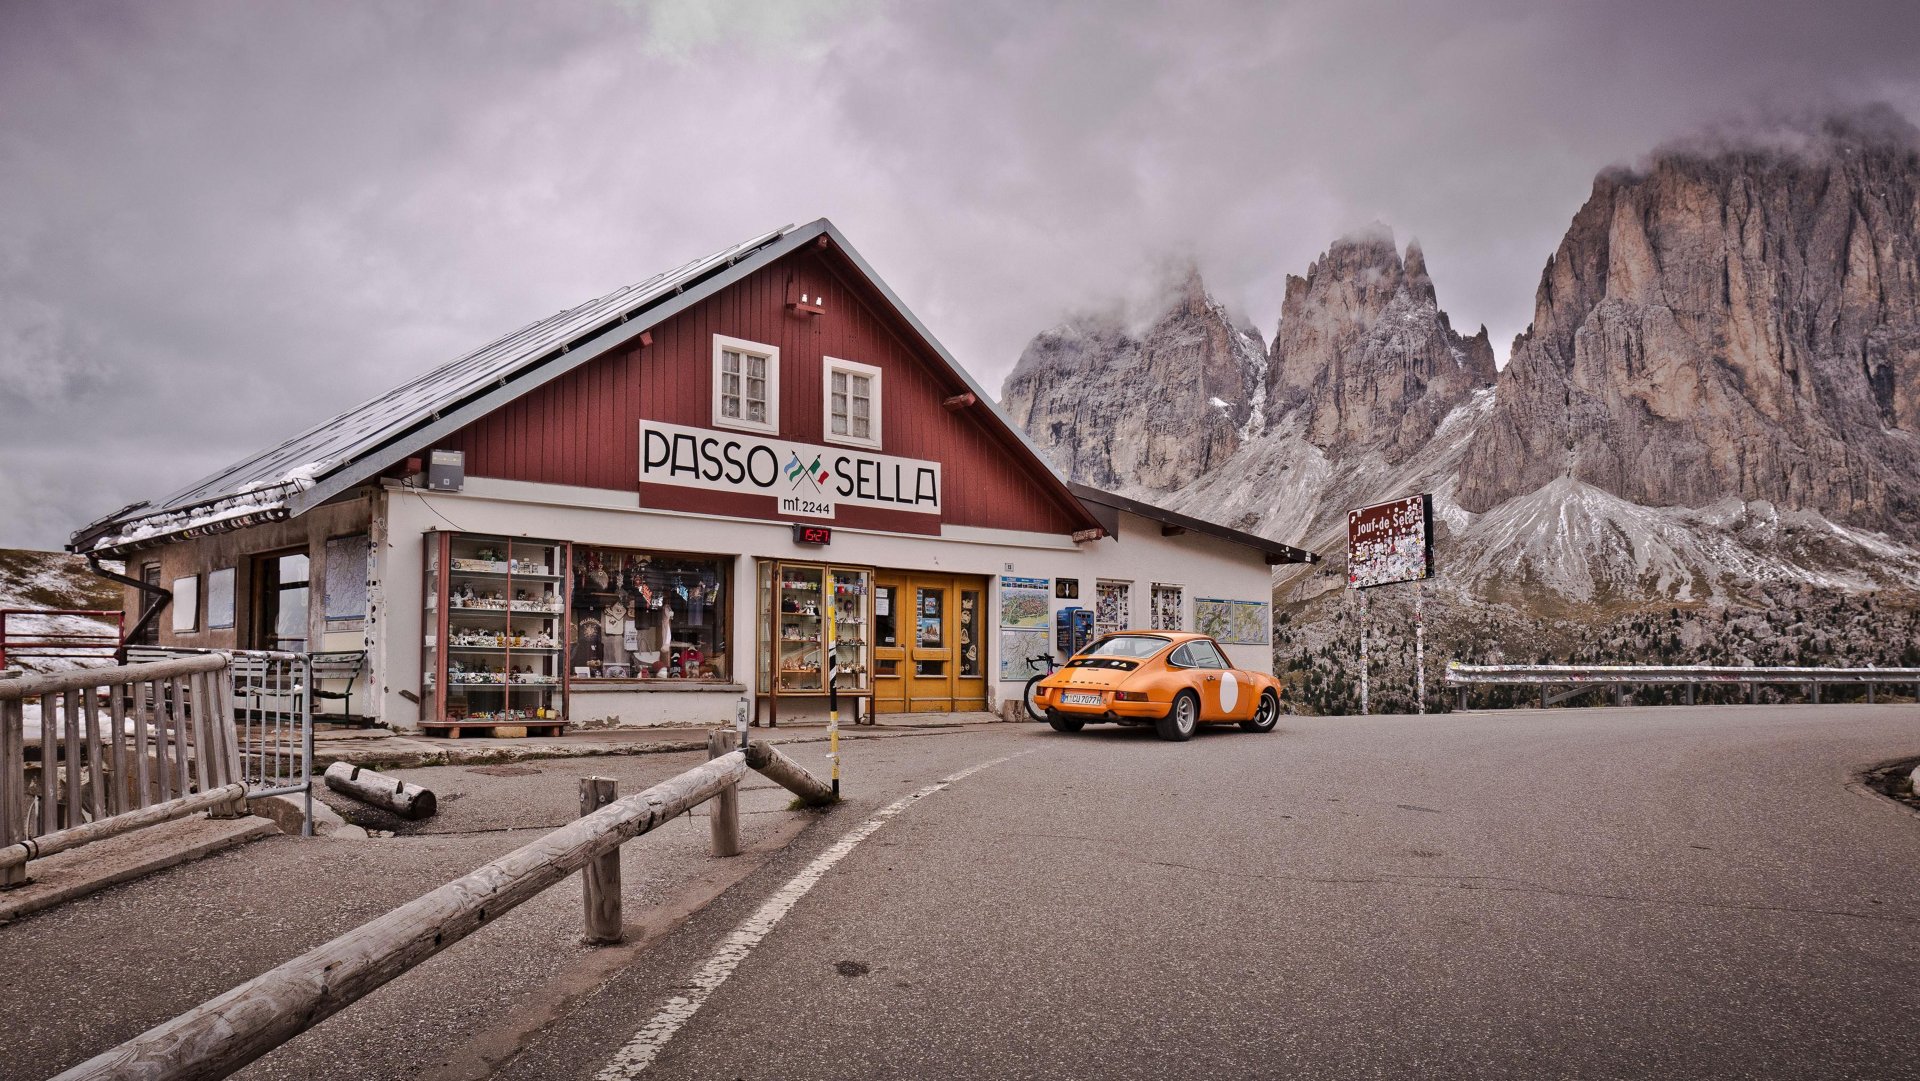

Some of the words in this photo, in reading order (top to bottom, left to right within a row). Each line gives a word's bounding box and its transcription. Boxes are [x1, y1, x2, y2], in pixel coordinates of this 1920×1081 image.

[643, 428, 779, 488] PASSO
[834, 456, 938, 507] SELLA
[1357, 518, 1376, 537] jouf
[1379, 516, 1390, 529] de
